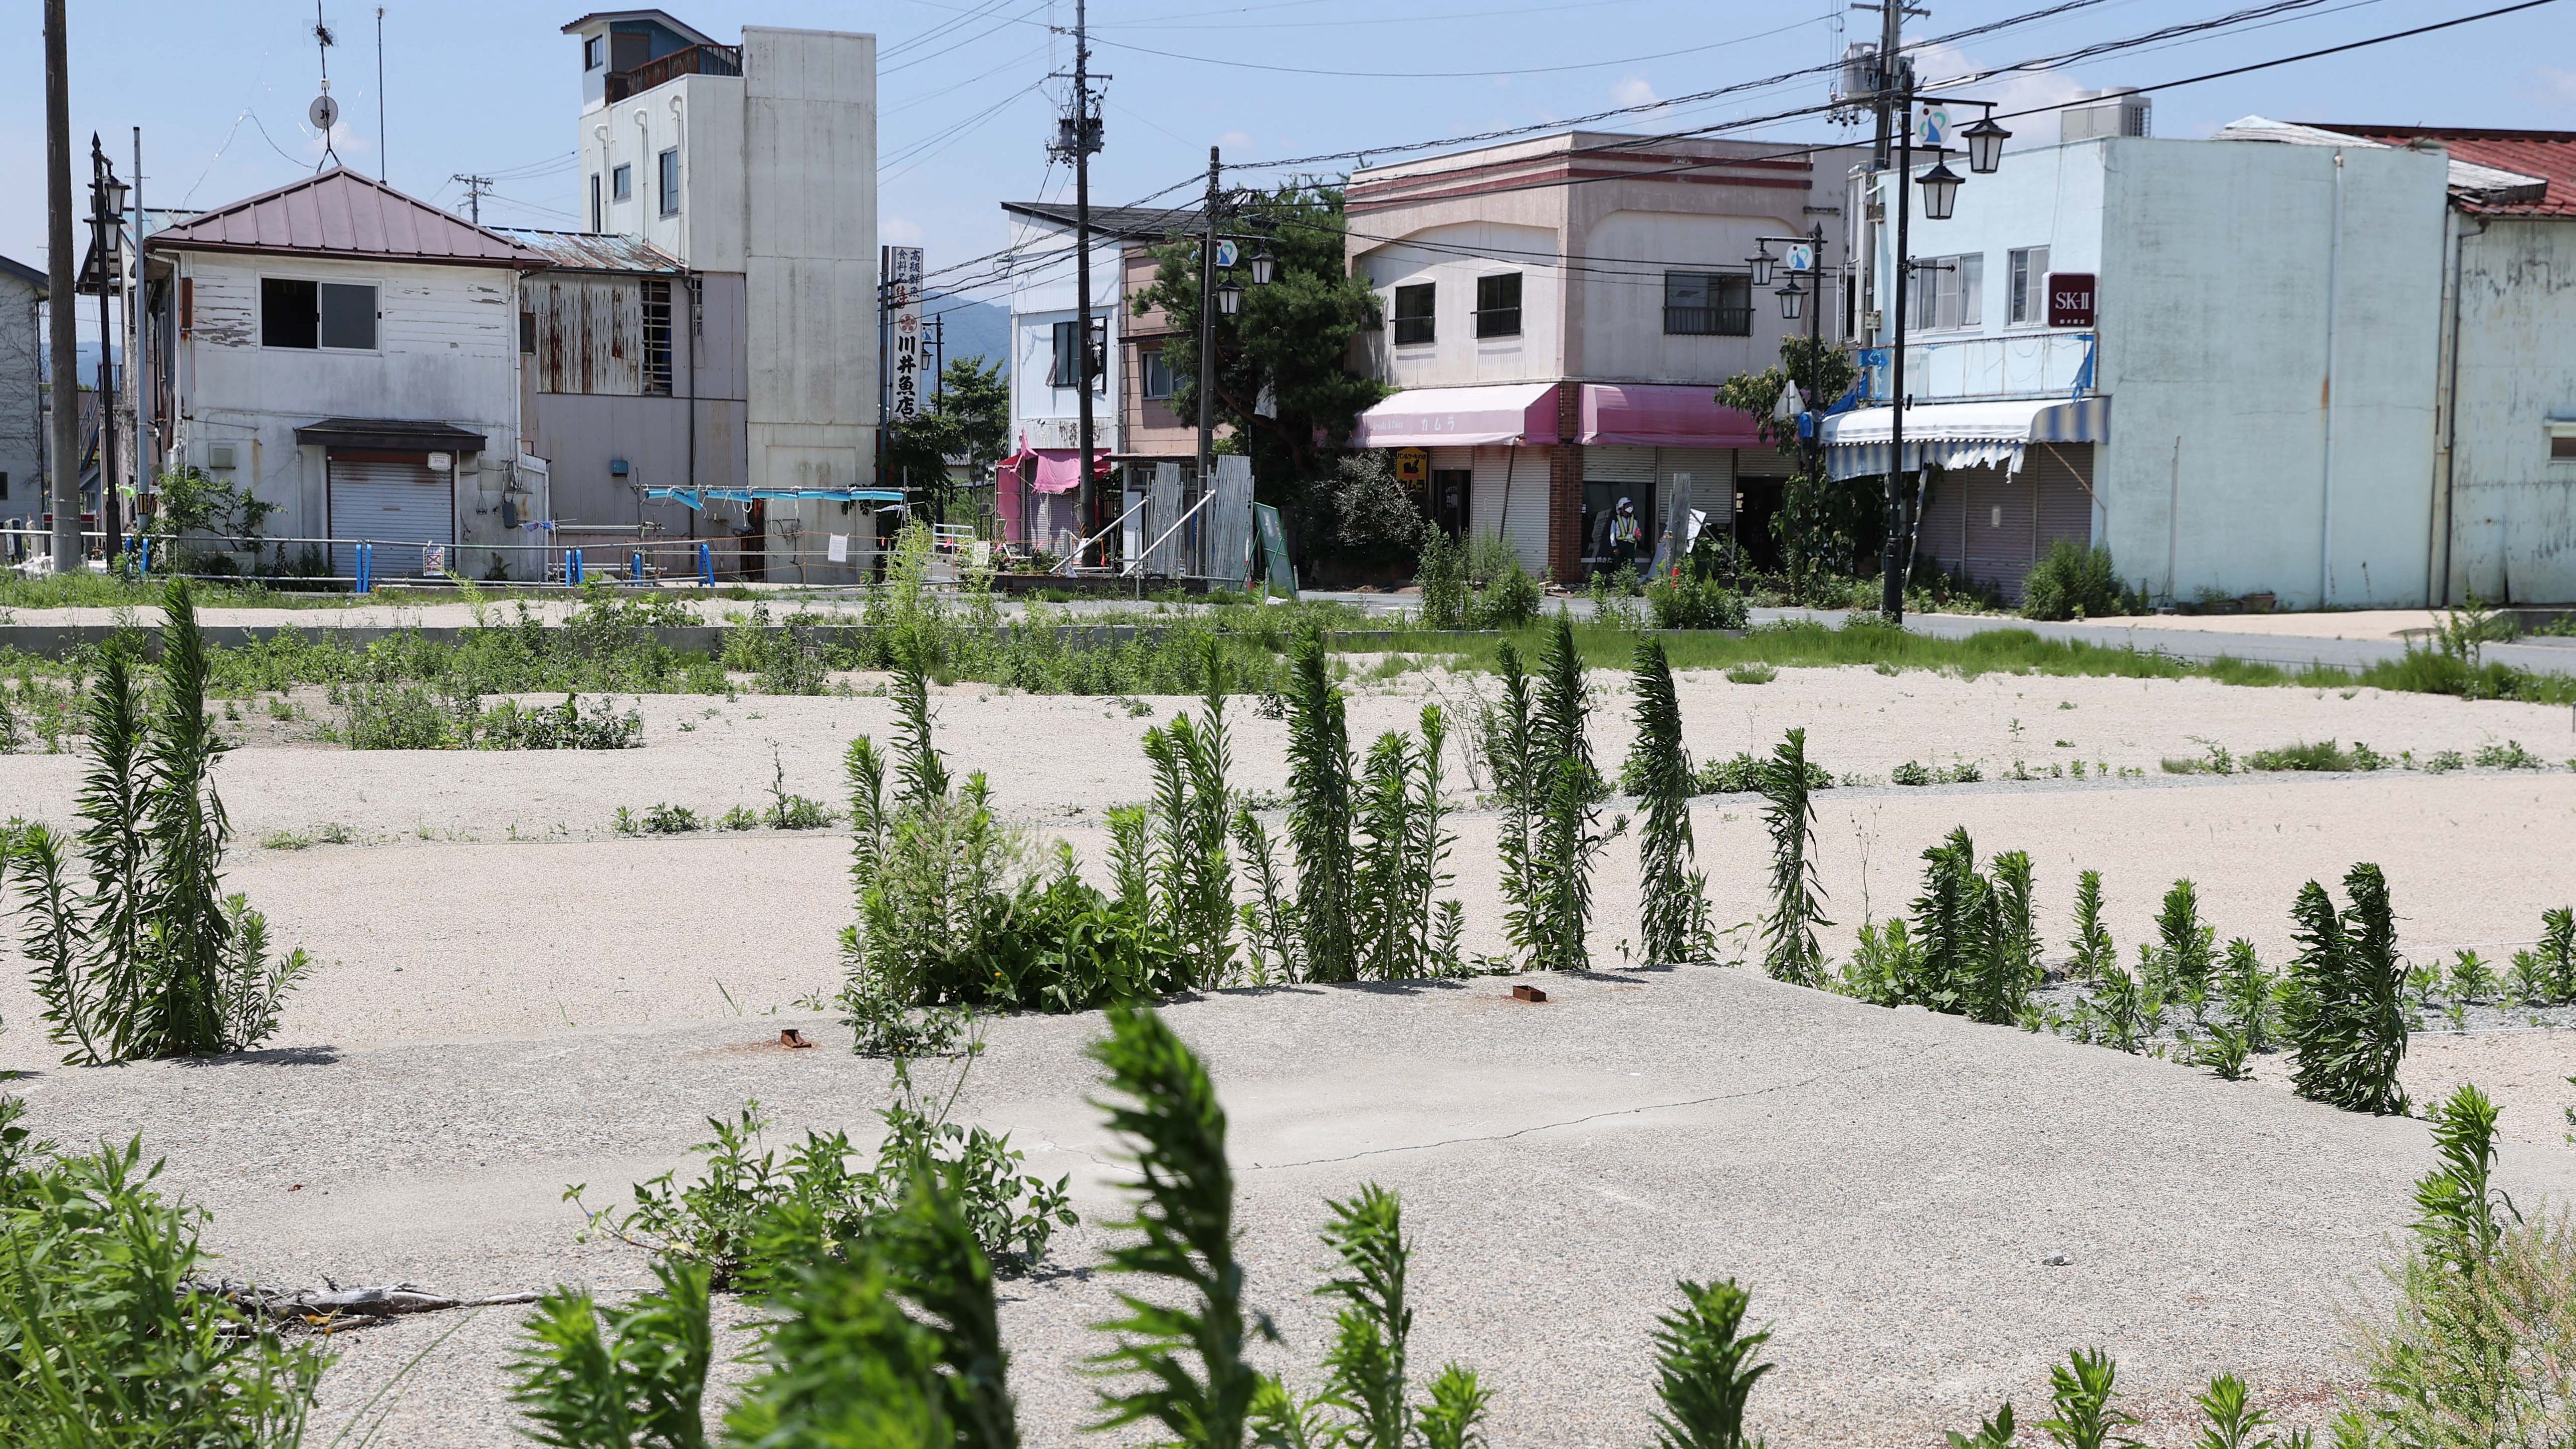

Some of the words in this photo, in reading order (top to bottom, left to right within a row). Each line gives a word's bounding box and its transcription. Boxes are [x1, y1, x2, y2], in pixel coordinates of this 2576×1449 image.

[897, 249, 908, 283] 食料品
[909, 250, 921, 298] 高級鮮魚
[2055, 292, 2090, 310] SK-II
[895, 335, 917, 418] 川井魚店
[1421, 417, 1455, 432] カムラ
